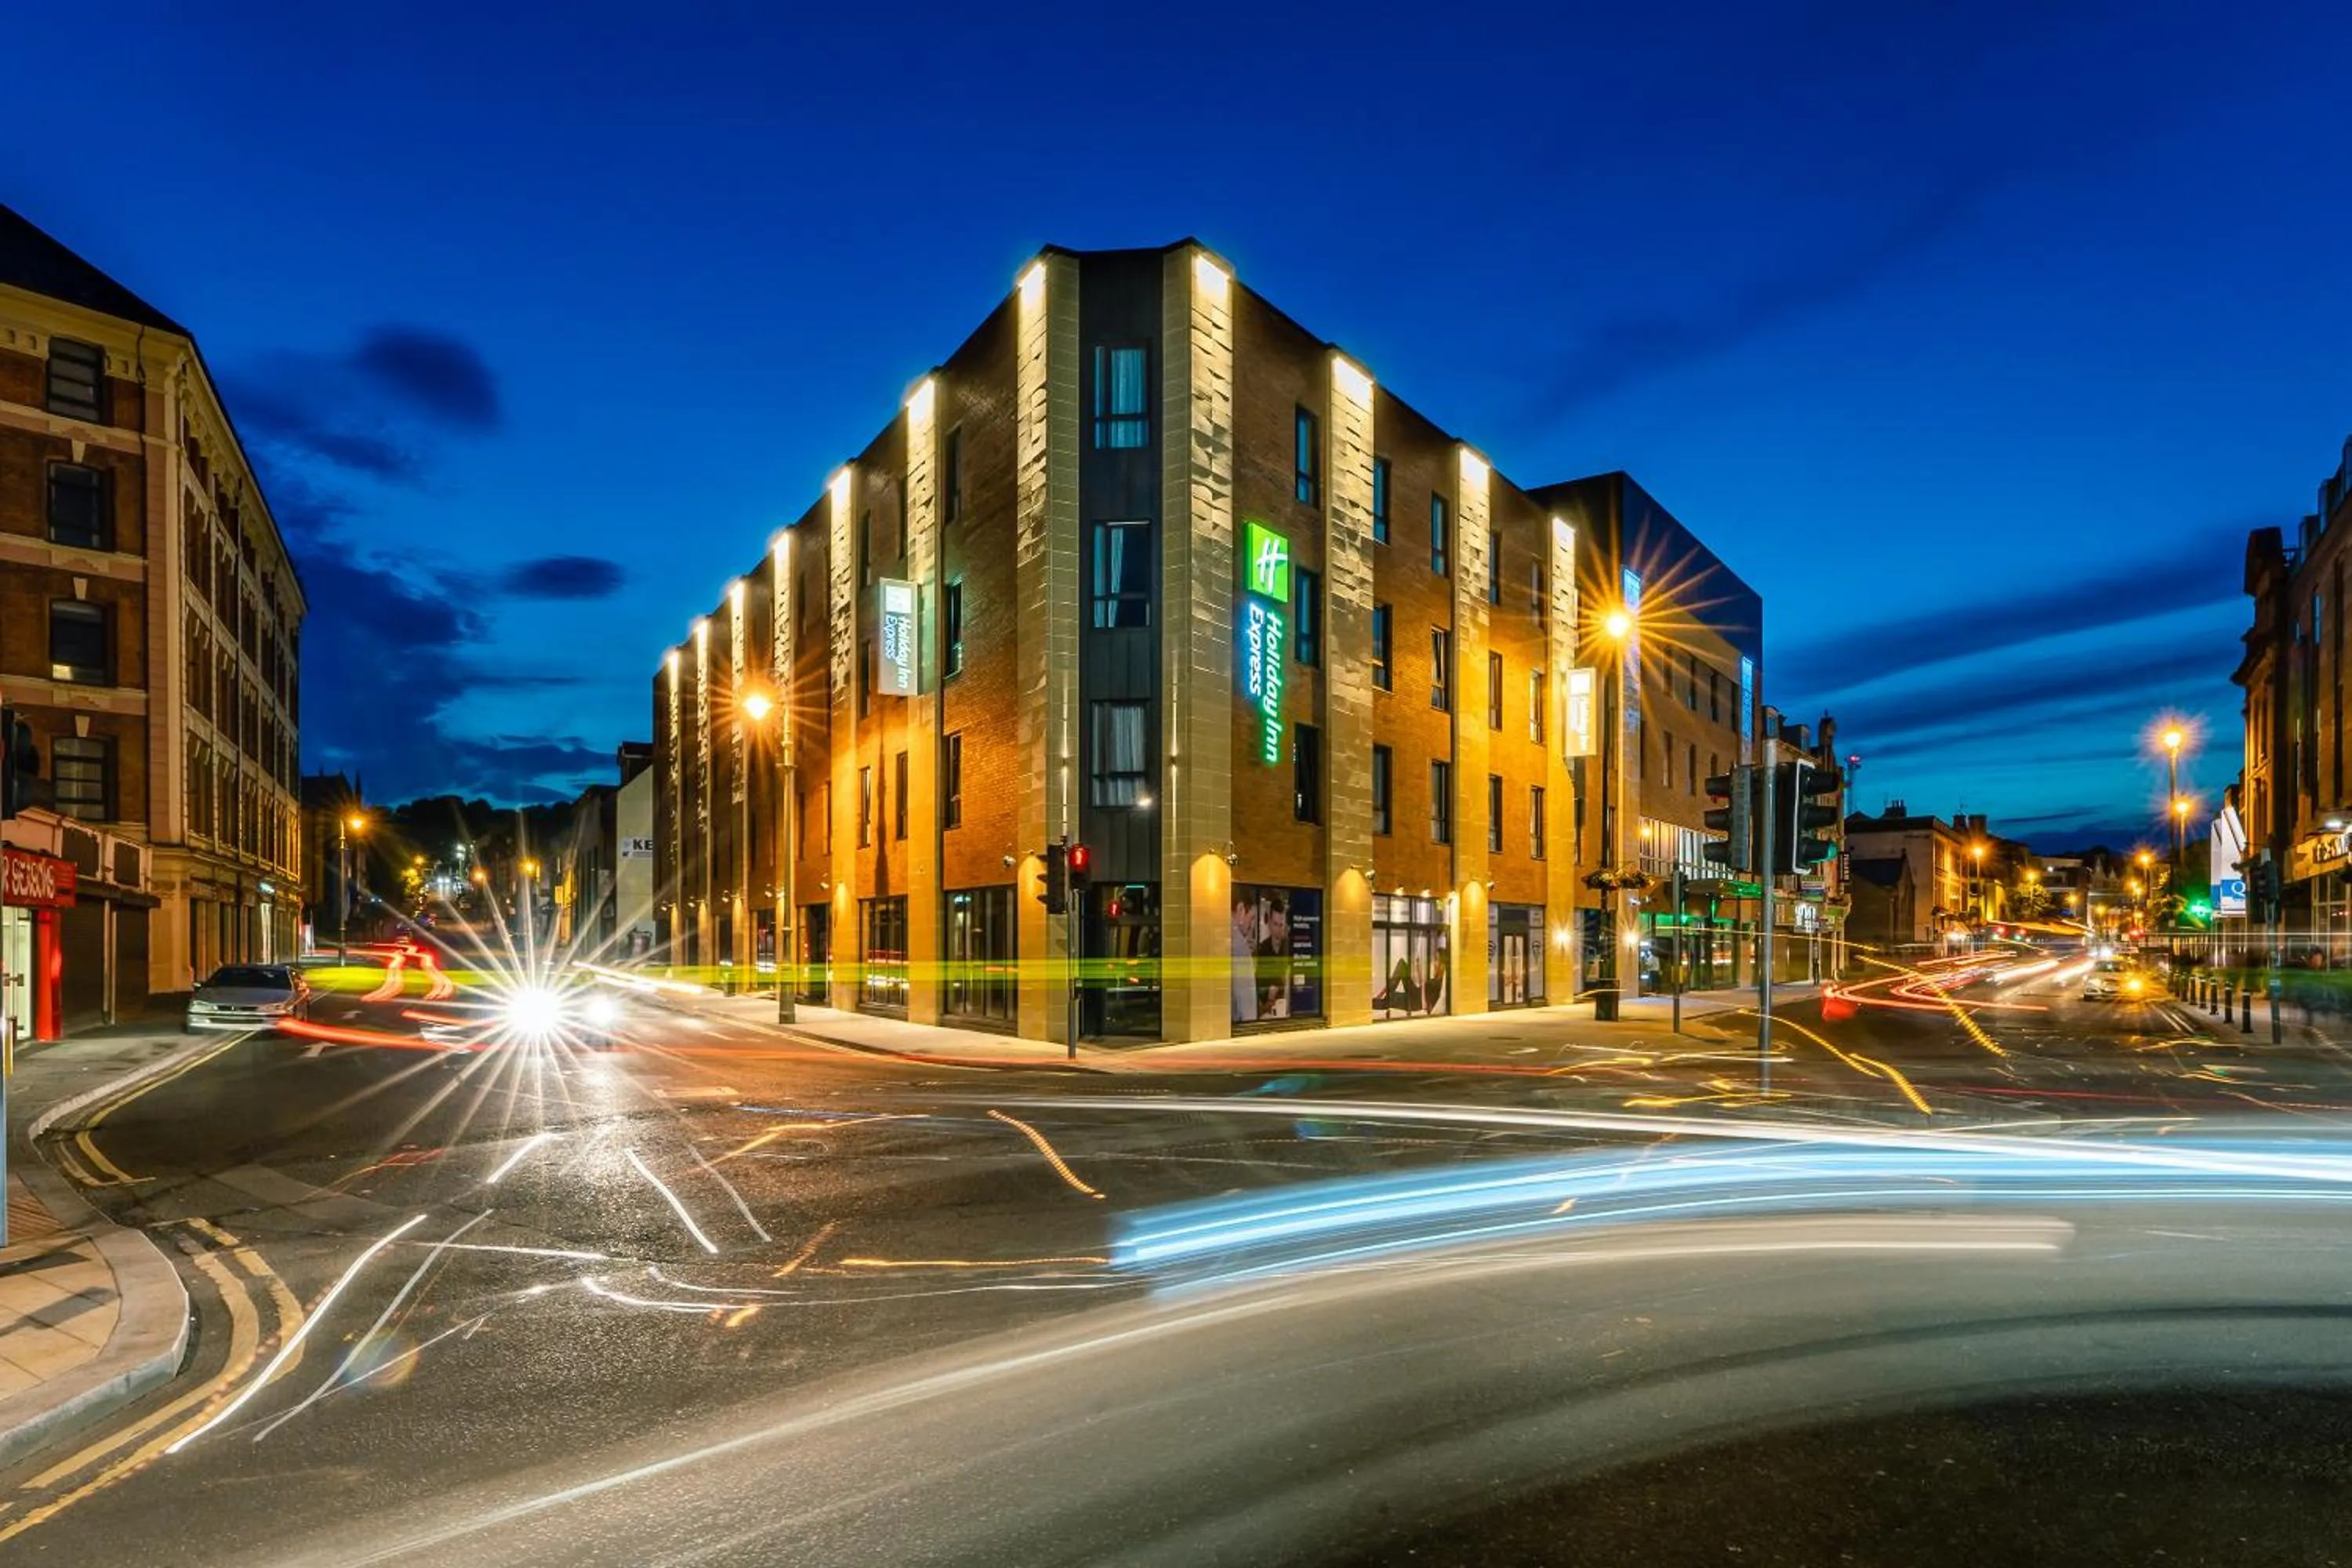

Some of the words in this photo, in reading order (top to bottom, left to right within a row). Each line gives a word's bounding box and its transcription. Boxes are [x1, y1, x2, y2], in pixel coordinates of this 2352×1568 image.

[884, 615, 897, 659] Express
[895, 615, 912, 666] Holiday
[1248, 602, 1264, 695] Express
[898, 666, 911, 689] Inn
[1263, 610, 1283, 717] Holiday
[1265, 717, 1283, 763] Inn
